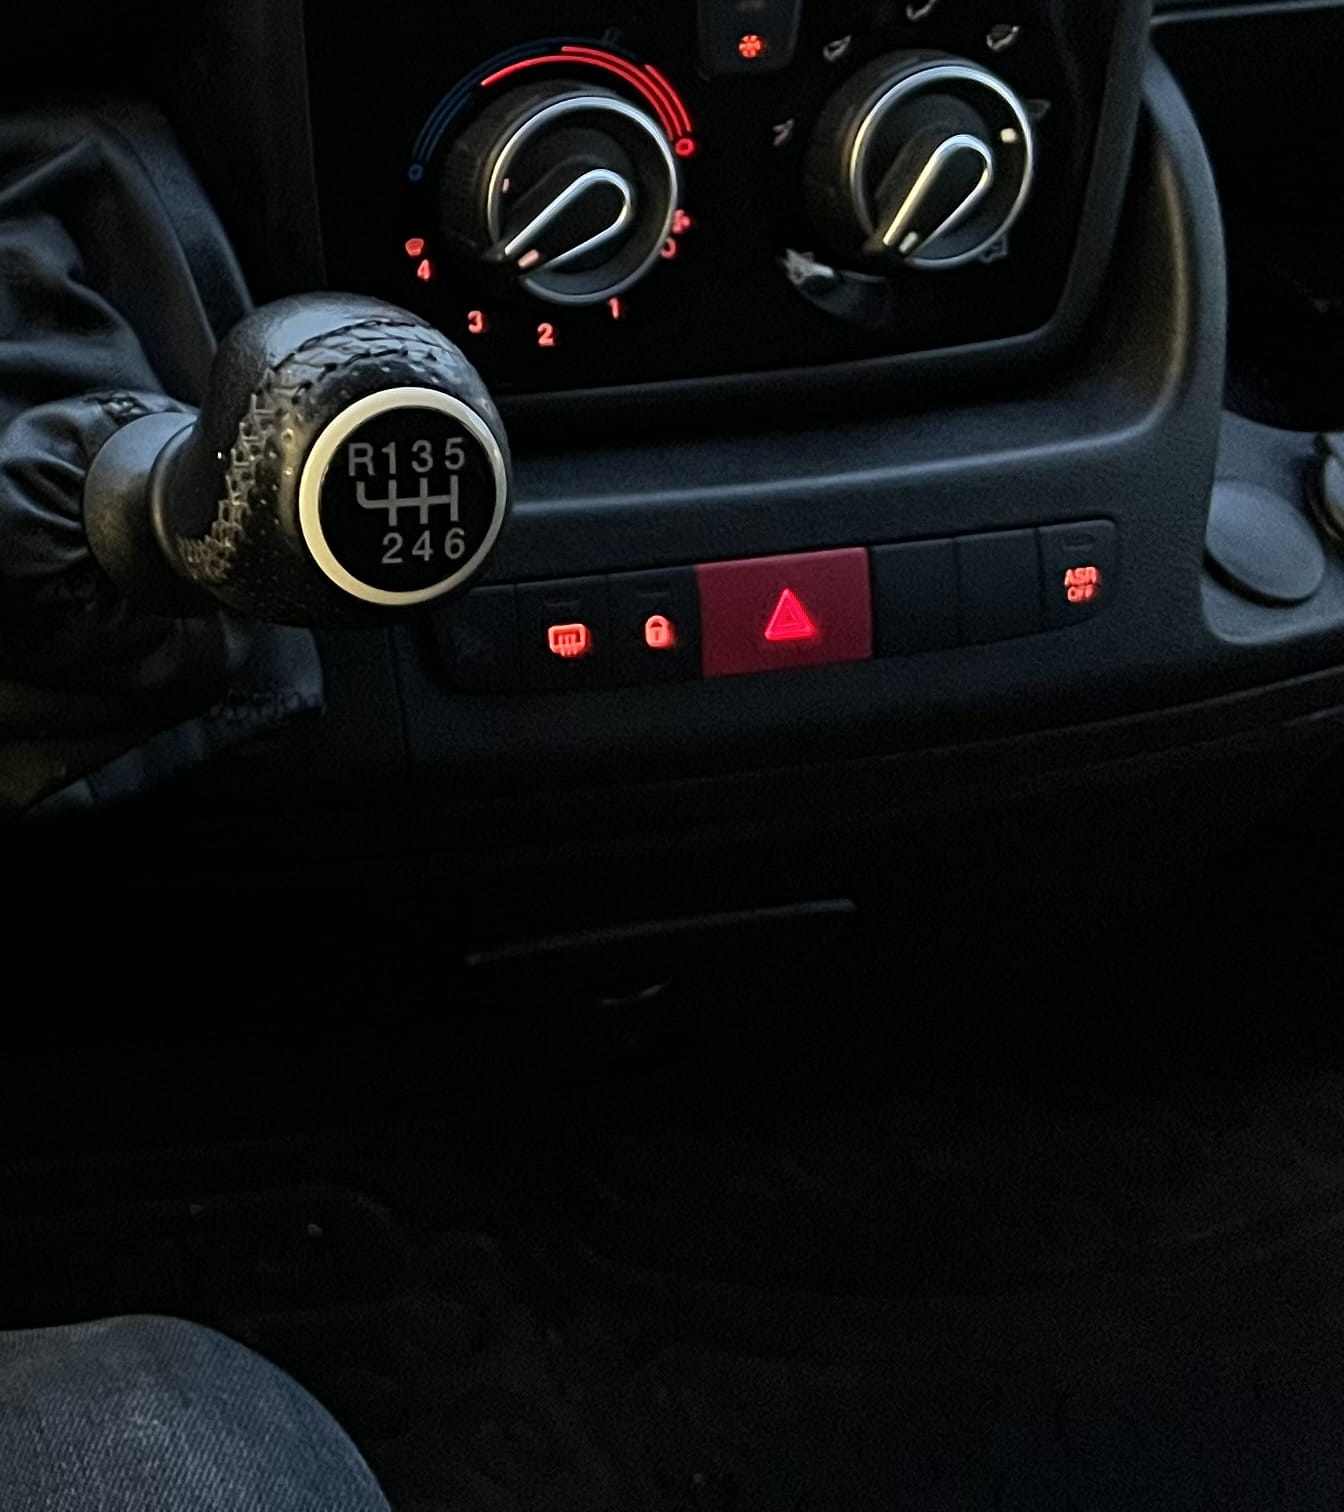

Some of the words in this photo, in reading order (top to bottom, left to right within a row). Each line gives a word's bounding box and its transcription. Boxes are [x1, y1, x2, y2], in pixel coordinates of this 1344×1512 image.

[417, 259, 432, 281] 4
[609, 298, 620, 319] 1
[467, 310, 485, 333] 3
[537, 323, 555, 346] 2
[348, 442, 375, 477] R
[381, 441, 397, 474] 1
[411, 440, 433, 473] 3
[444, 437, 465, 470] 5
[381, 532, 403, 564] 2
[412, 530, 434, 562] 4
[444, 527, 465, 559] 6
[1064, 567, 1097, 586] ASR
[1067, 584, 1094, 603] OFF
